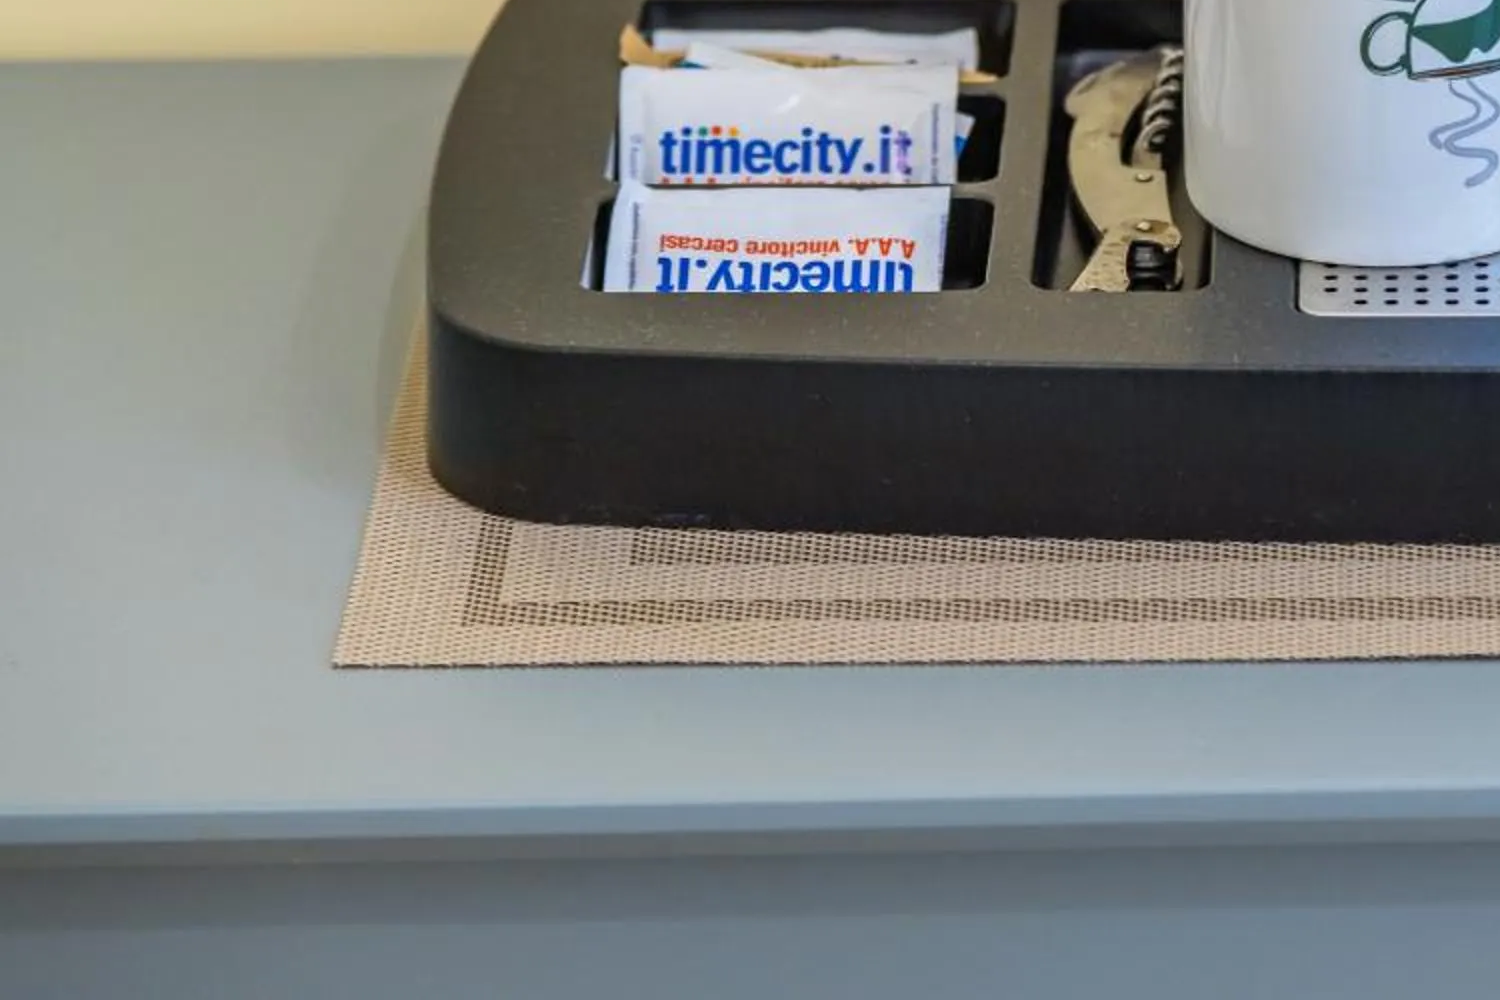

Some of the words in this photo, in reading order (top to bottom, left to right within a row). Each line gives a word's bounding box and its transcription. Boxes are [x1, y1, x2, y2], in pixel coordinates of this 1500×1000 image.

[659, 125, 913, 175] timecity.it
[659, 233, 739, 254] cercasi
[745, 239, 841, 258] vincitore
[848, 236, 915, 260] A.A.A.
